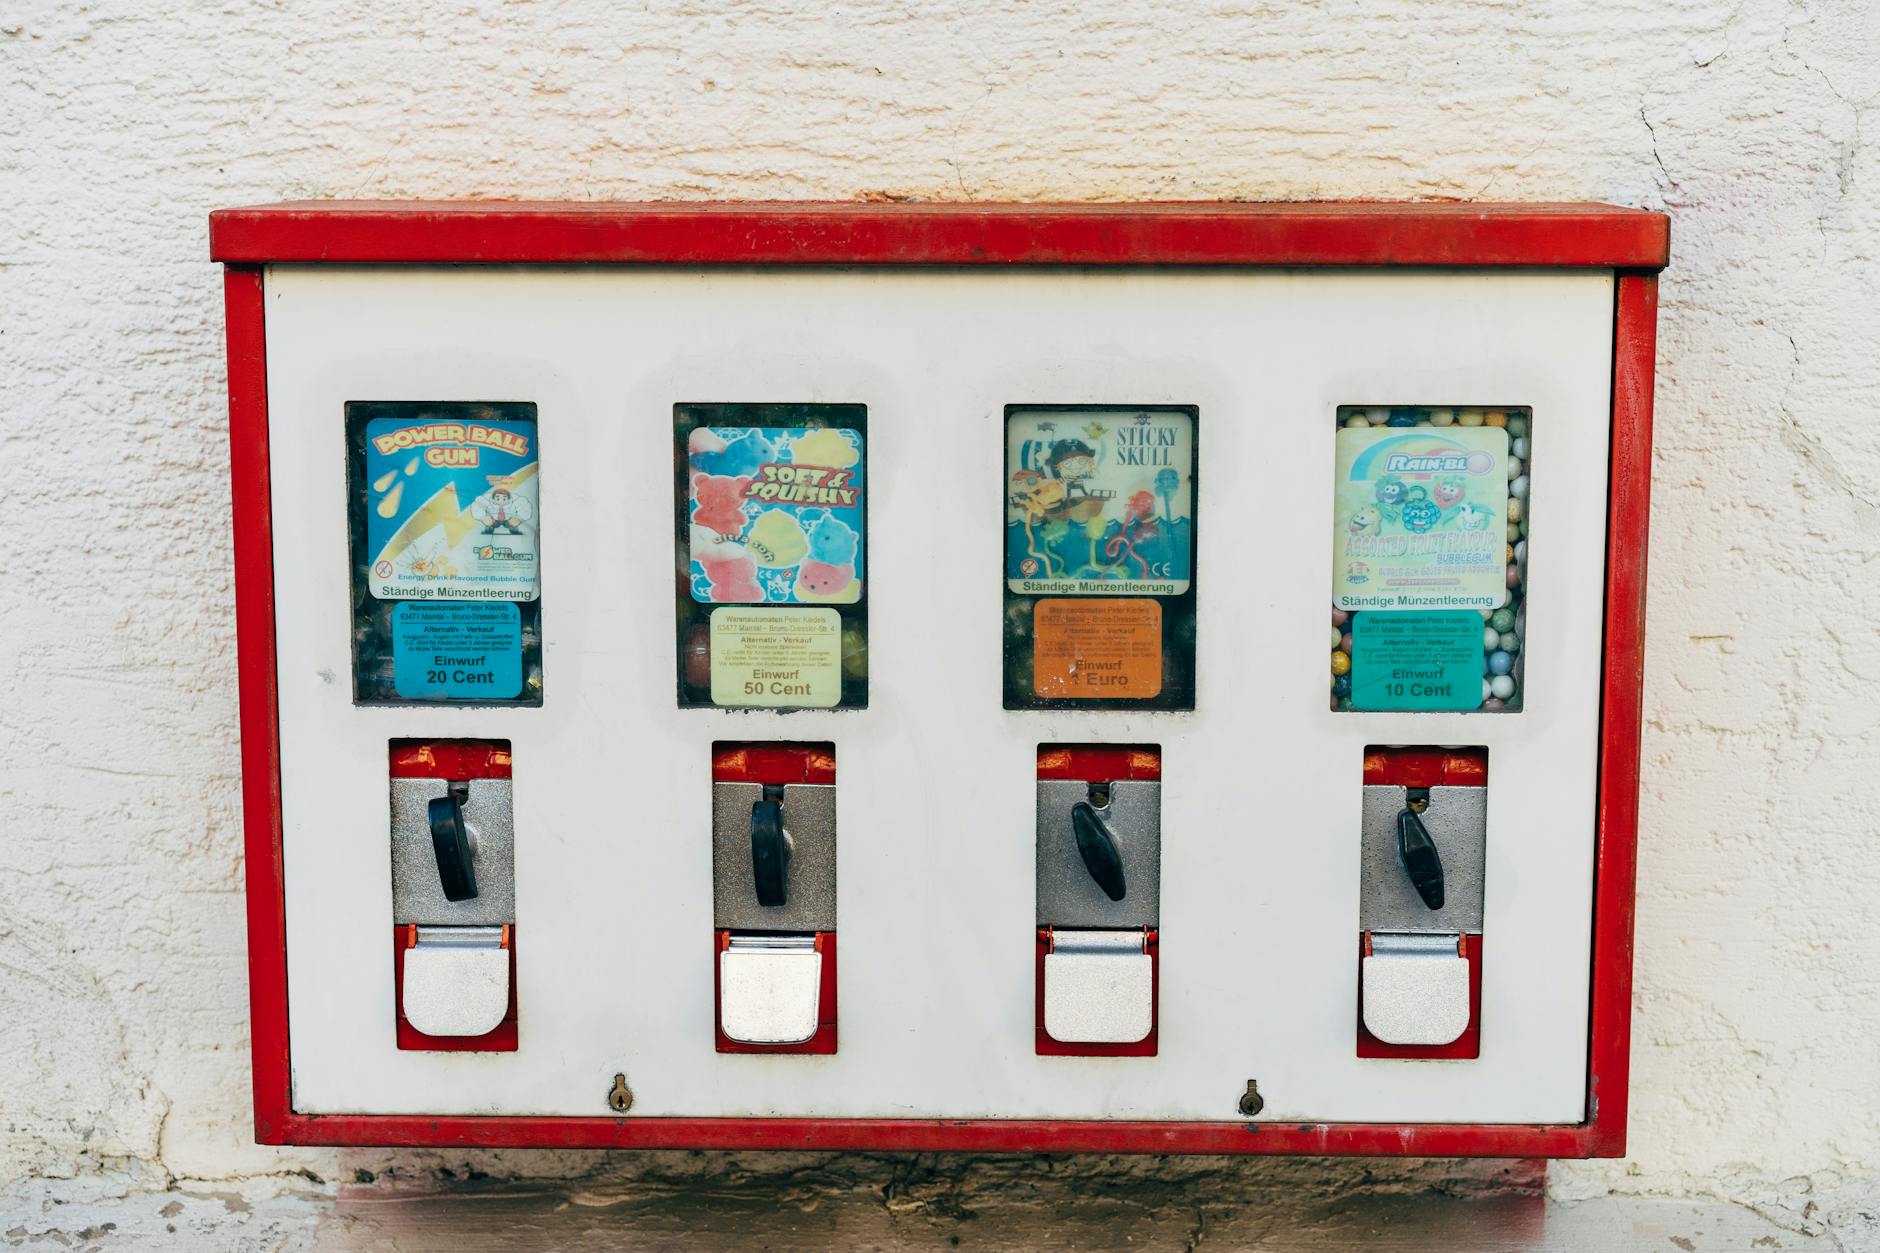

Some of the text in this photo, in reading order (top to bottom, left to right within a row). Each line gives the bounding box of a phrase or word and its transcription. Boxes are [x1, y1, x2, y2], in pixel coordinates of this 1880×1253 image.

[373, 424, 528, 456] POWER BALL
[1116, 427, 1178, 447] STICKY
[425, 447, 479, 467] GUM
[1116, 447, 1173, 466] SKULL
[763, 466, 828, 486] SOFT
[745, 482, 856, 505] SQUISHY
[1436, 553, 1493, 564] BUBBLEGUM
[1151, 562, 1171, 576] CE
[398, 574, 425, 583] Energy
[382, 586, 532, 600] Ständige Münzentleerung
[1023, 581, 1174, 593] Ständige Münzentleerung
[1341, 595, 1493, 608] Ständige Münzentleerung
[434, 655, 486, 666] Einwurf
[1076, 660, 1122, 670] Einwurf
[427, 670, 494, 684] 20 Cent
[752, 669, 799, 680] Einwurf
[1072, 673, 1128, 686] 1 Euro
[1392, 668, 1444, 679] Einwurf
[744, 682, 812, 695] 50 Cent
[1385, 683, 1452, 697] 10 Cent
